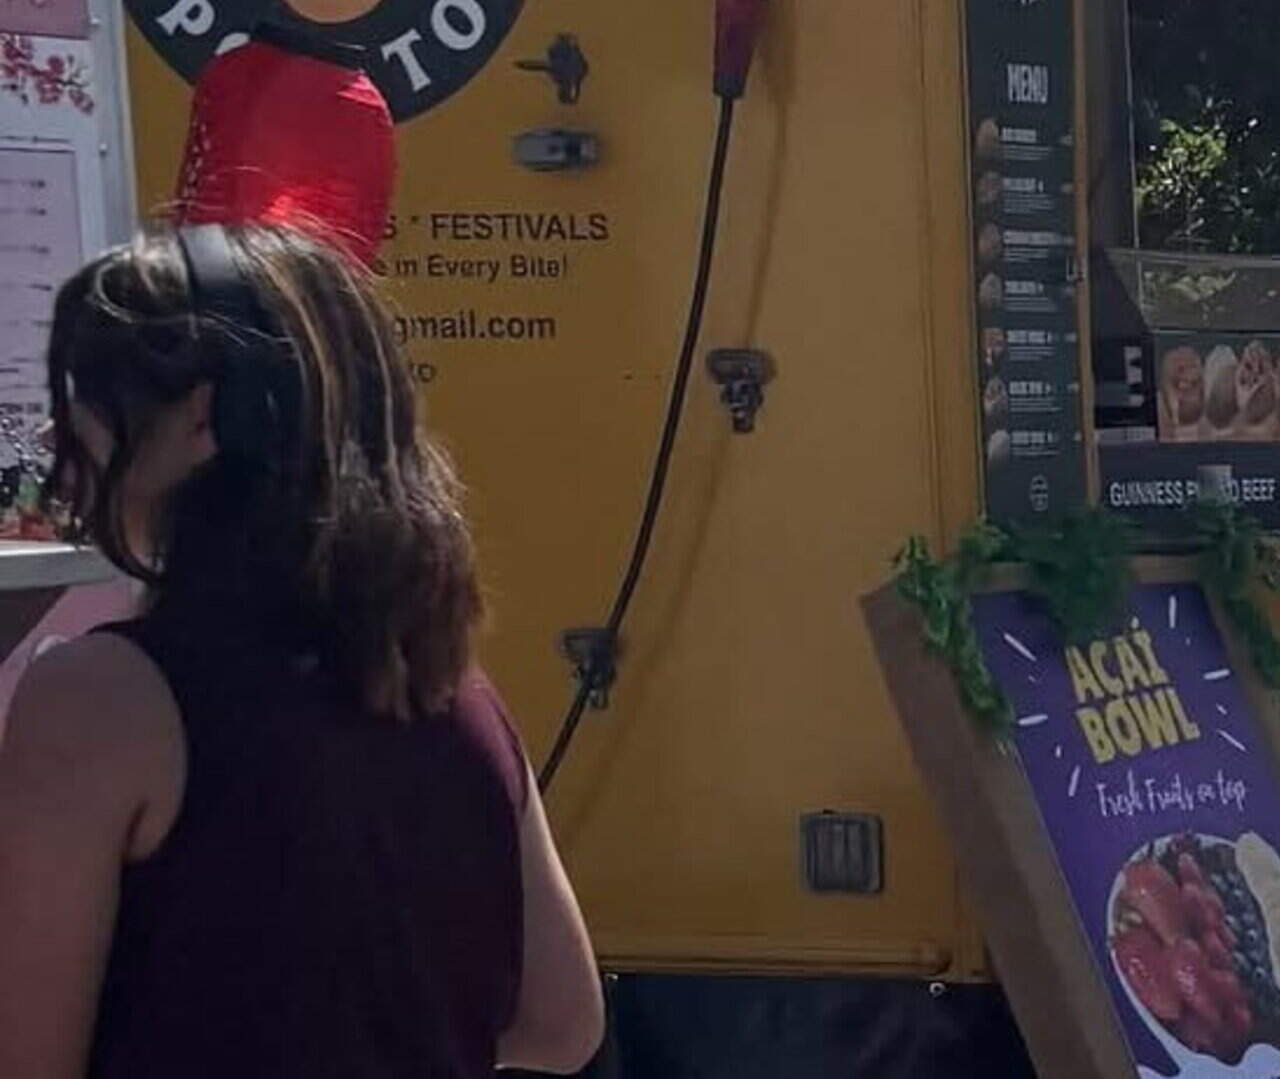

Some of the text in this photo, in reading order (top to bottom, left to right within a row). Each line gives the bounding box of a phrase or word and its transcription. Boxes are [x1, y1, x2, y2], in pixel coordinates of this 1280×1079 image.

[1006, 63, 1049, 104] MENU
[430, 212, 610, 241] FESTIVALS
[427, 254, 500, 283] Every
[1109, 479, 1184, 507] GUINNESS
[1242, 477, 1276, 501] BEEF
[1075, 687, 1201, 764] BOWL
[1096, 771, 1144, 817] Fresh
[1216, 771, 1246, 811] top
